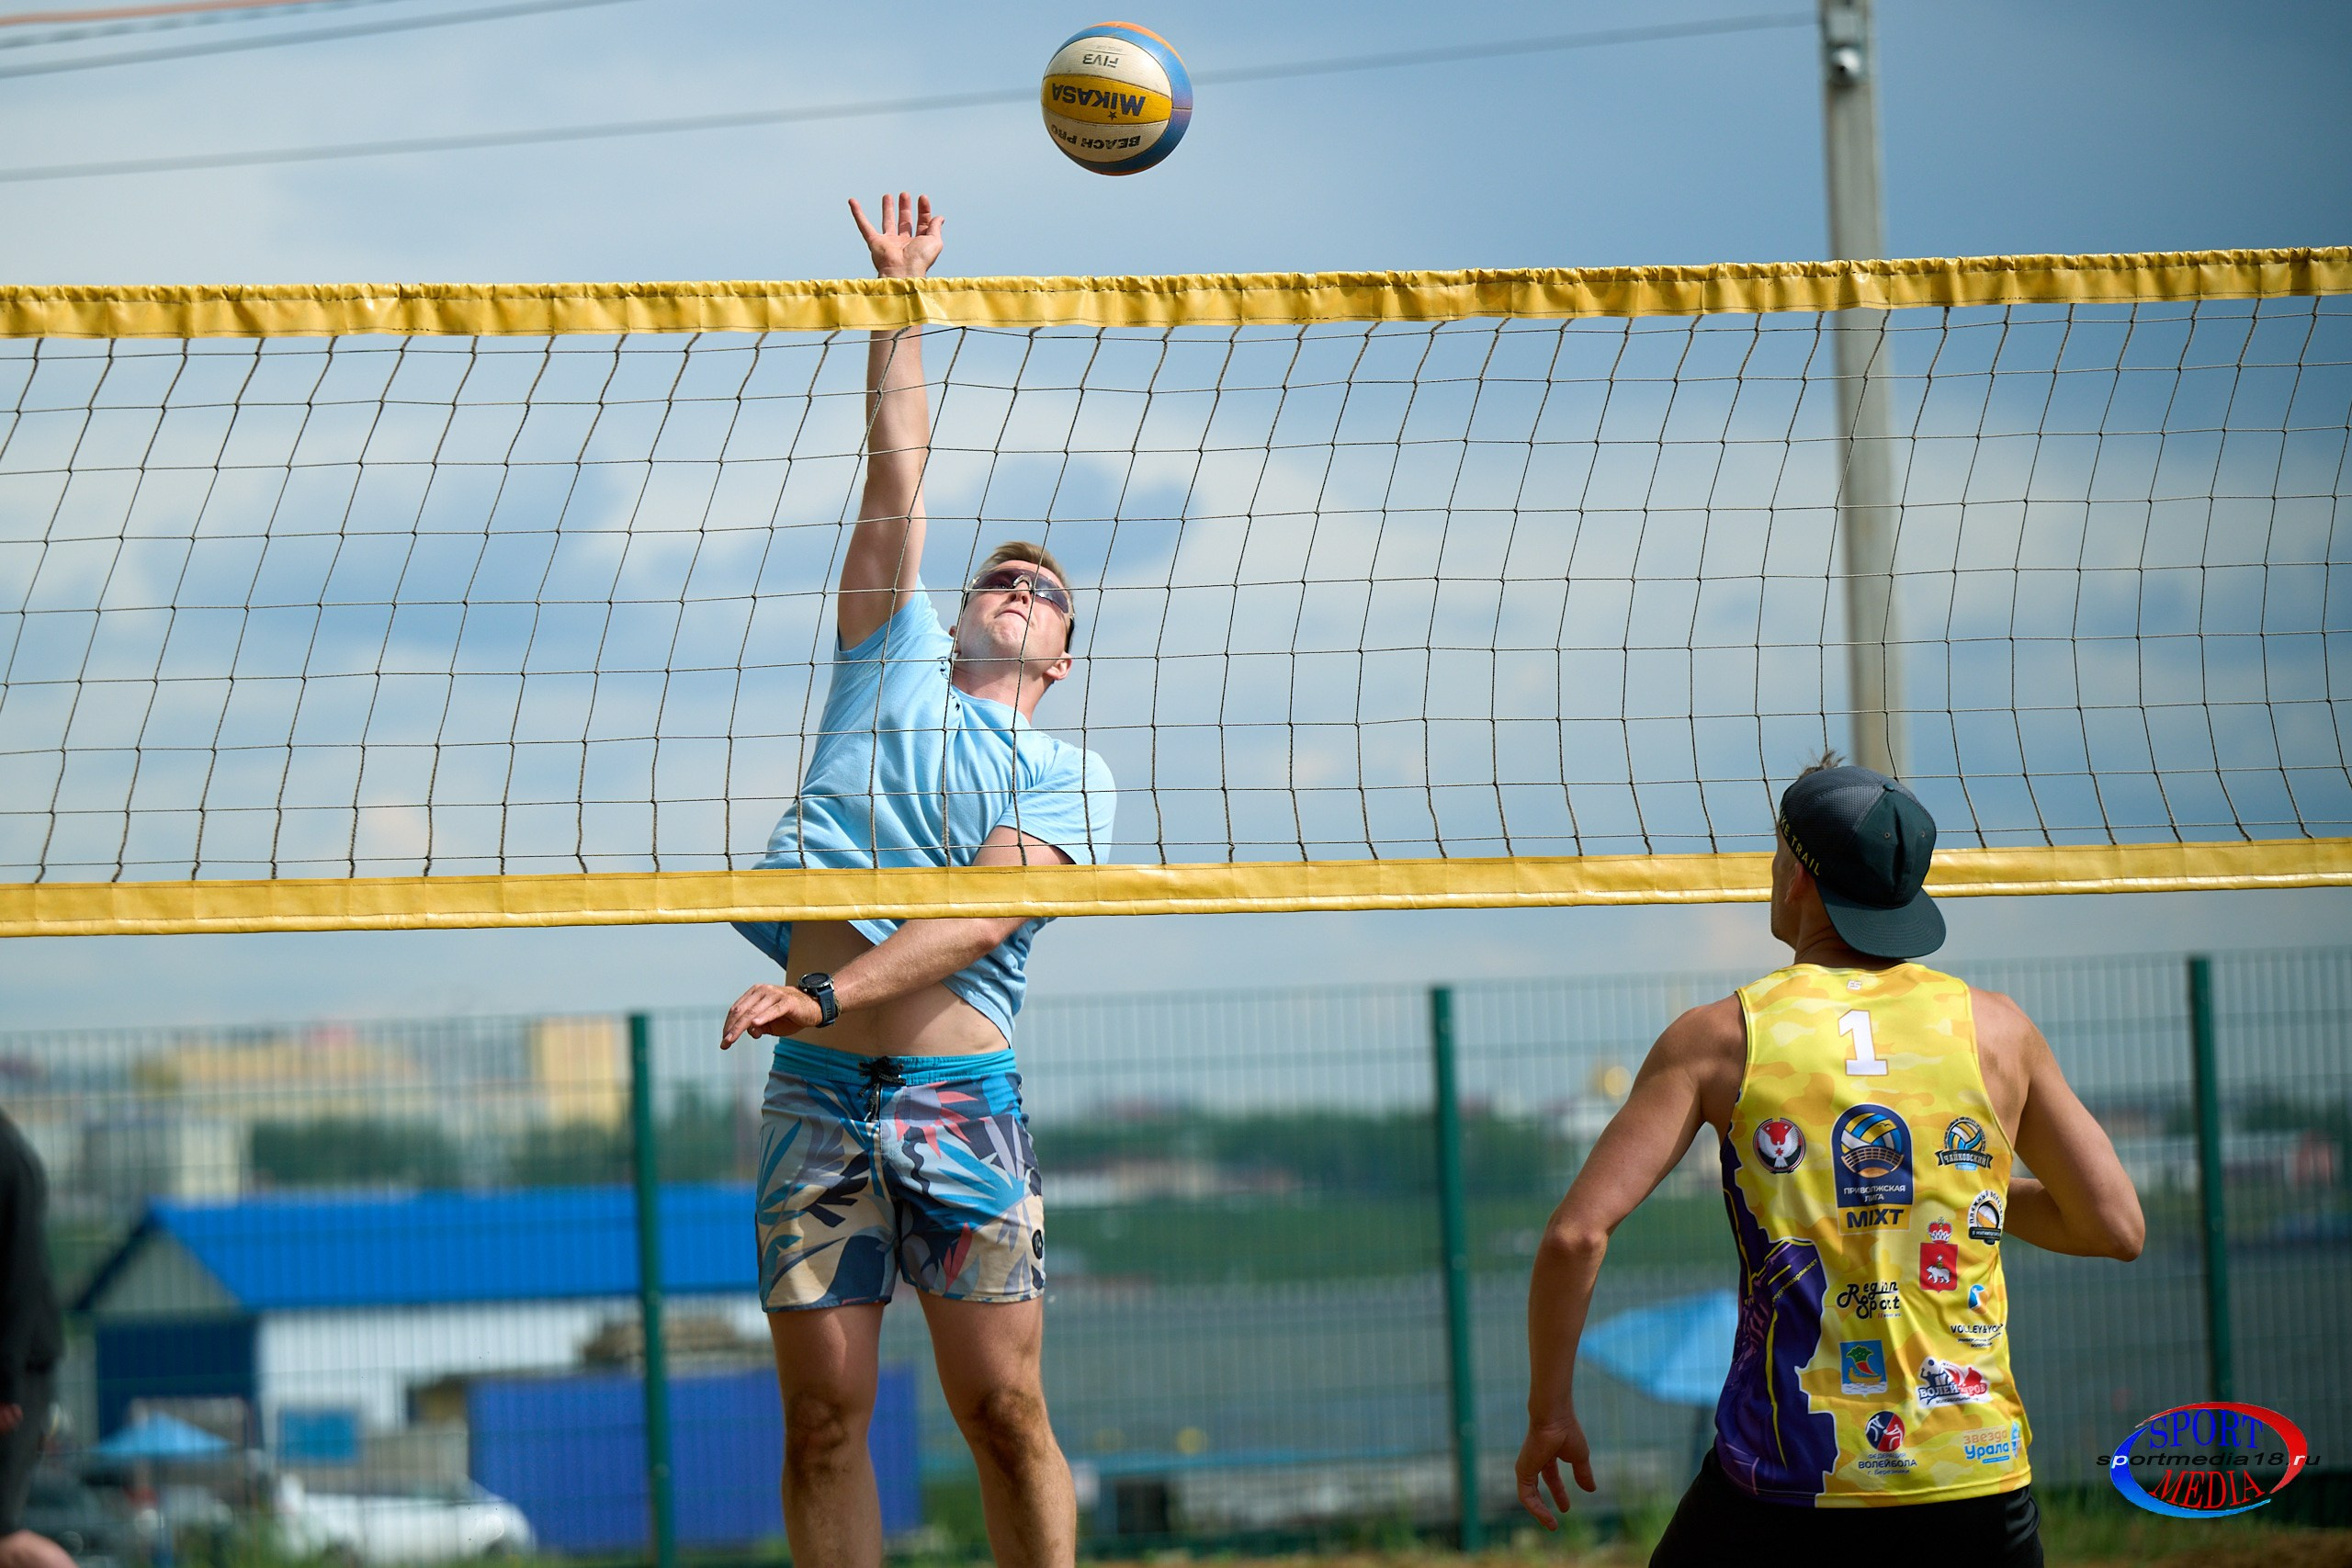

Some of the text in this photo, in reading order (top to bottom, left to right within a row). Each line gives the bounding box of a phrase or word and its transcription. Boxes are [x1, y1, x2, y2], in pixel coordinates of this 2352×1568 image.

[1052, 83, 1146, 117] MIKASA
[1051, 124, 1141, 150] BEACH PRO
[1792, 835, 1819, 876] TRAIL
[1838, 1009, 1888, 1076] 1
[1944, 1152, 1987, 1166] ЧАЙКОВСКИЙ
[1843, 1184, 1906, 1195] ПРИВОЛЖСКАЯ
[1864, 1193, 1884, 1202] ЛИГА
[1847, 1208, 1905, 1228] MIXT
[1837, 1281, 1899, 1308] Region
[1858, 1459, 1917, 1469] ВОЛЕЙБОЛА
